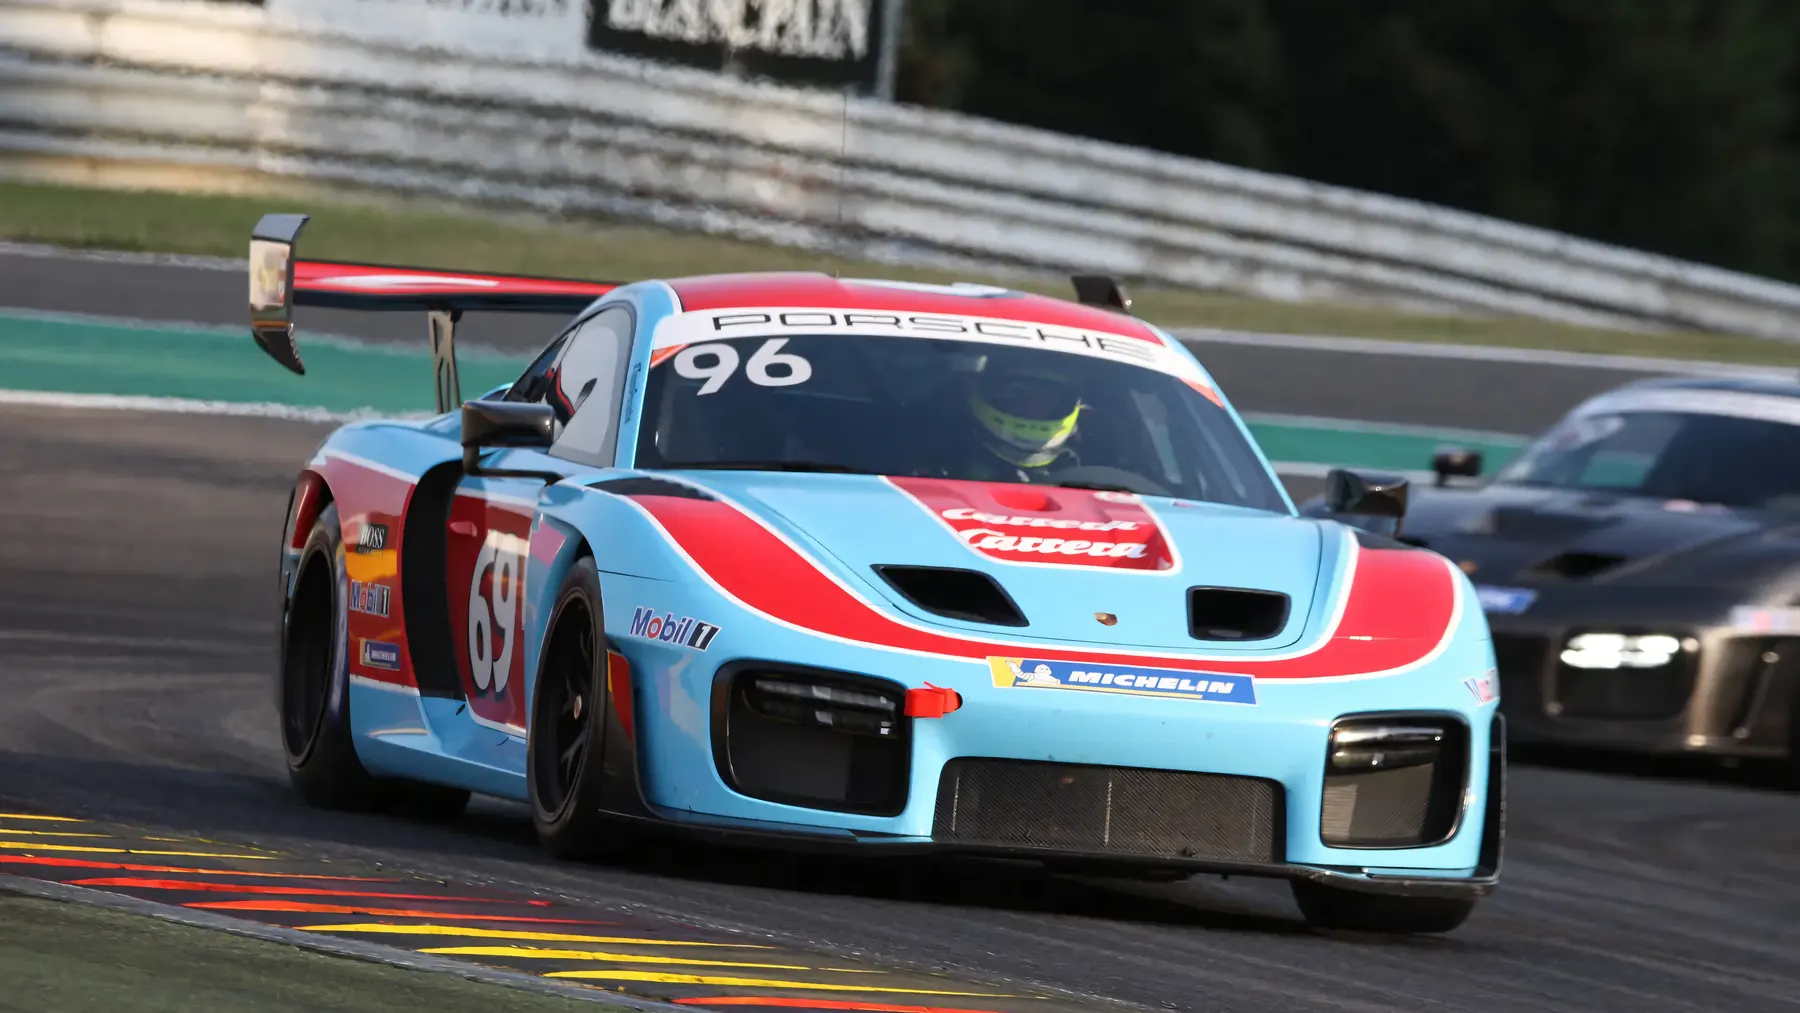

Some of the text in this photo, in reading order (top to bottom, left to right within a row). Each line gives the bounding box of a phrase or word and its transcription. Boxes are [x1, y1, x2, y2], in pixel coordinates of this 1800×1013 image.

[712, 312, 1157, 363] PORSCHE
[673, 338, 812, 396] 96
[941, 508, 1144, 531] Carrera
[360, 525, 385, 549] BOSS
[957, 528, 1148, 559] Carrera
[351, 581, 378, 614] Mobil
[468, 530, 520, 694] 69
[629, 607, 695, 645] Mobil
[1068, 670, 1236, 694] MICHELIN
